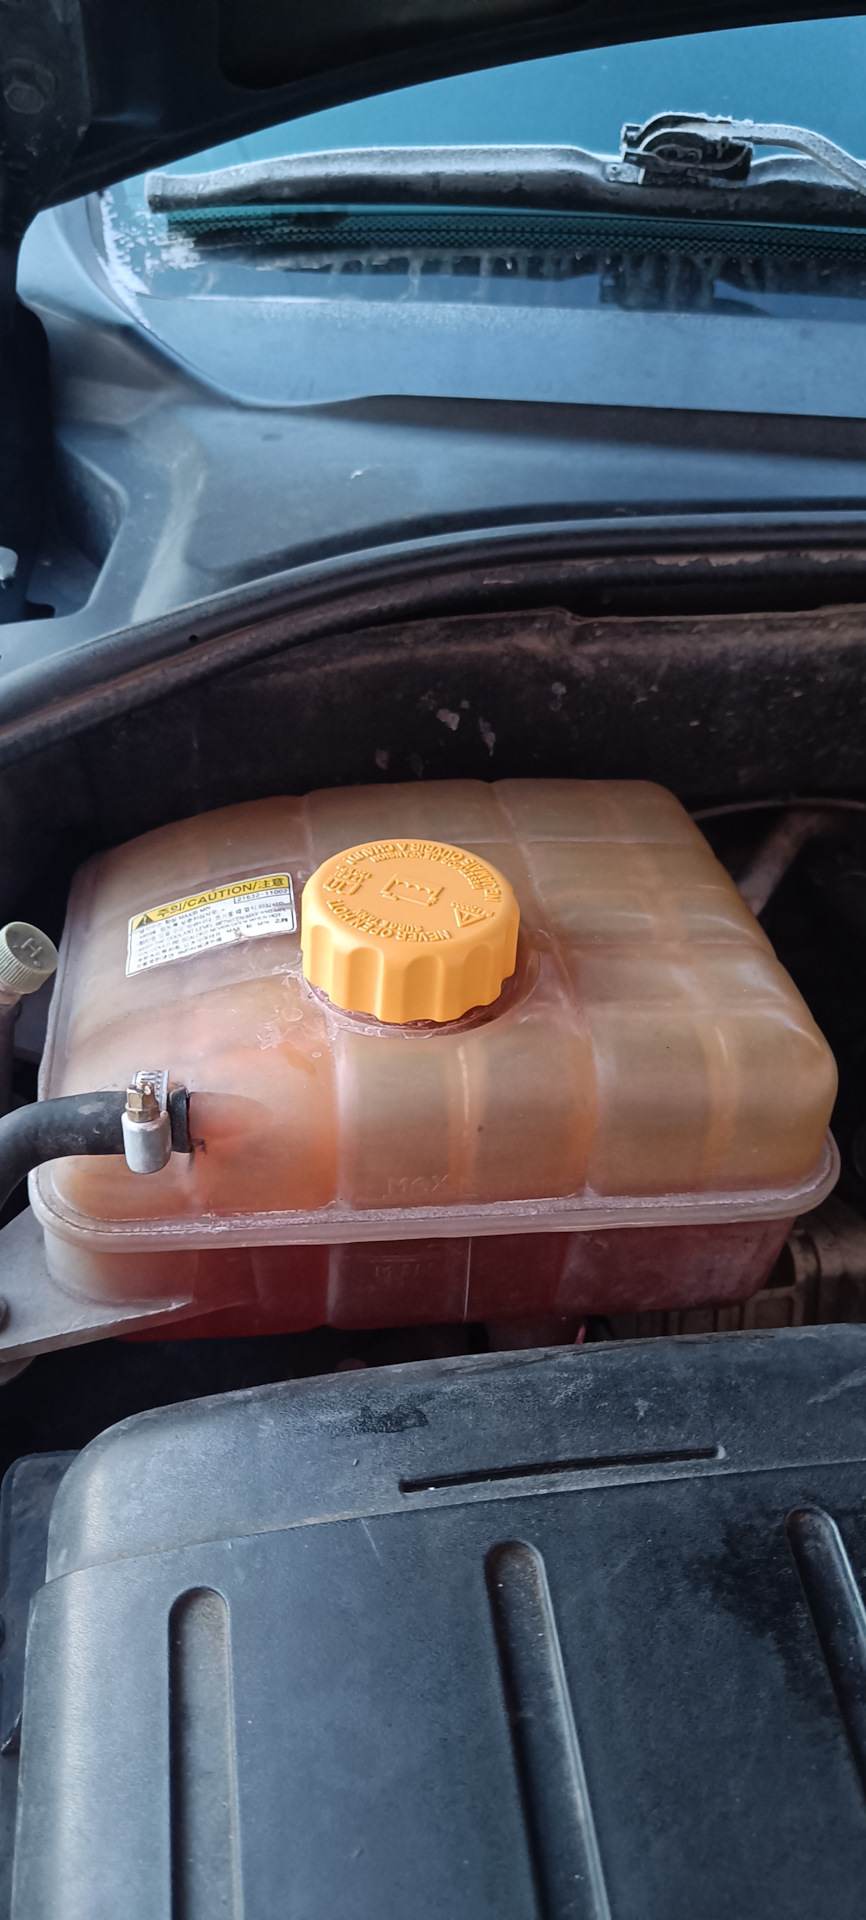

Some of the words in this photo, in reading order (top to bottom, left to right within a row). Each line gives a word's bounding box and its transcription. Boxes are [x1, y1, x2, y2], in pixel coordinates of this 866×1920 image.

[350, 918, 393, 939] OPEN
[395, 929, 452, 943] NEVER
[388, 1175, 449, 1194] MAX
